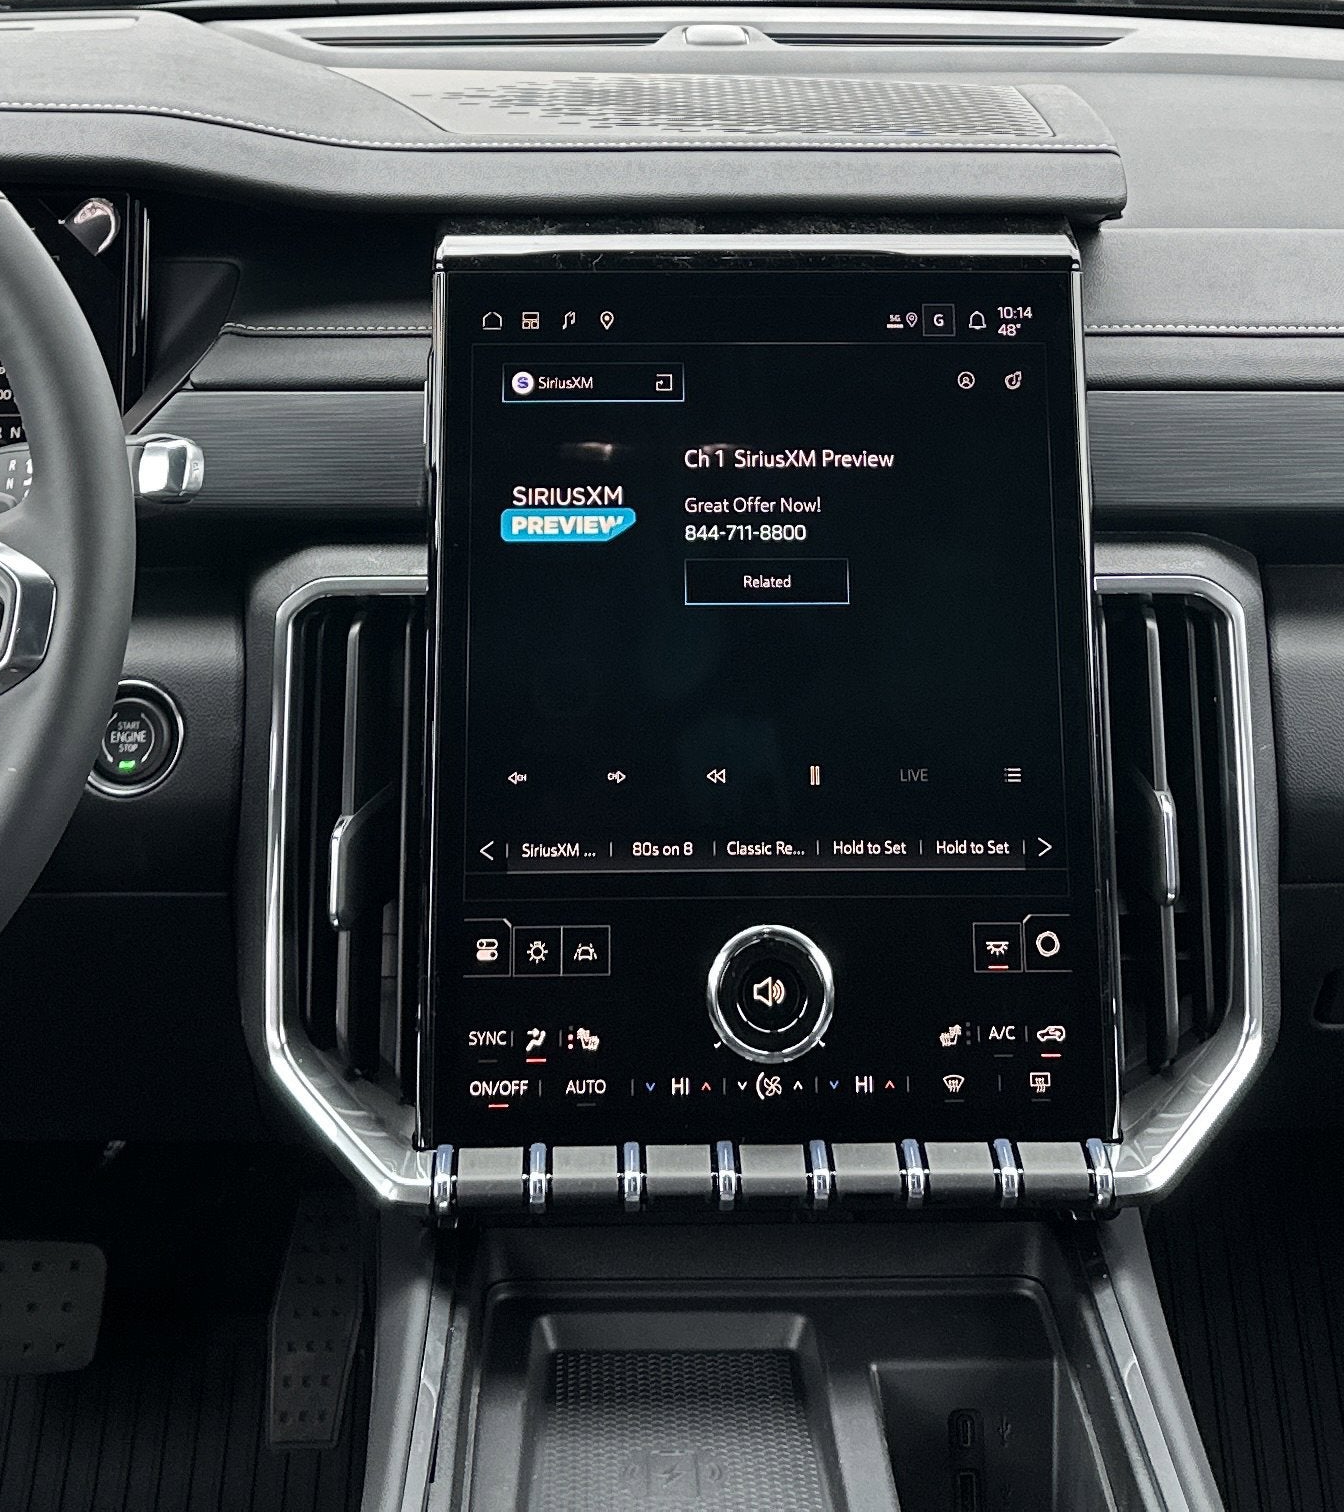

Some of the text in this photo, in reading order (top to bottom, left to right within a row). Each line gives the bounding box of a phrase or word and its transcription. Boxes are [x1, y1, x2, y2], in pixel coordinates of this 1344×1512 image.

[933, 314, 945, 327] G
[997, 306, 1033, 320] 10:14
[998, 324, 1022, 336] 48°
[538, 377, 594, 390] SiriusXM
[10, 426, 21, 439] N
[8, 458, 17, 471] R
[684, 449, 894, 468] Ch 1 SiriusXM Preview
[6, 477, 15, 489] N
[512, 486, 623, 506] SIRIUSXM
[684, 497, 821, 513] Great Offer Now!
[511, 515, 624, 535] PREVIEW
[684, 524, 807, 542] 844-711-8800
[743, 575, 792, 589] Related
[117, 721, 141, 730] START
[109, 730, 147, 743] ENGINE
[117, 743, 138, 753] STOP
[899, 768, 929, 782] LIVE
[521, 842, 580, 858] SiriusXM
[632, 841, 693, 857] 80s on 8
[726, 840, 772, 856] Classic
[833, 840, 907, 855] Hold to Set
[936, 840, 1010, 855] Hold to Set
[468, 1030, 507, 1046] SYNC
[988, 1025, 1016, 1041] A/C
[469, 1079, 529, 1096] ON/OFF
[565, 1079, 606, 1095] AUTO
[671, 1077, 689, 1096] HI
[855, 1075, 873, 1093] HI
